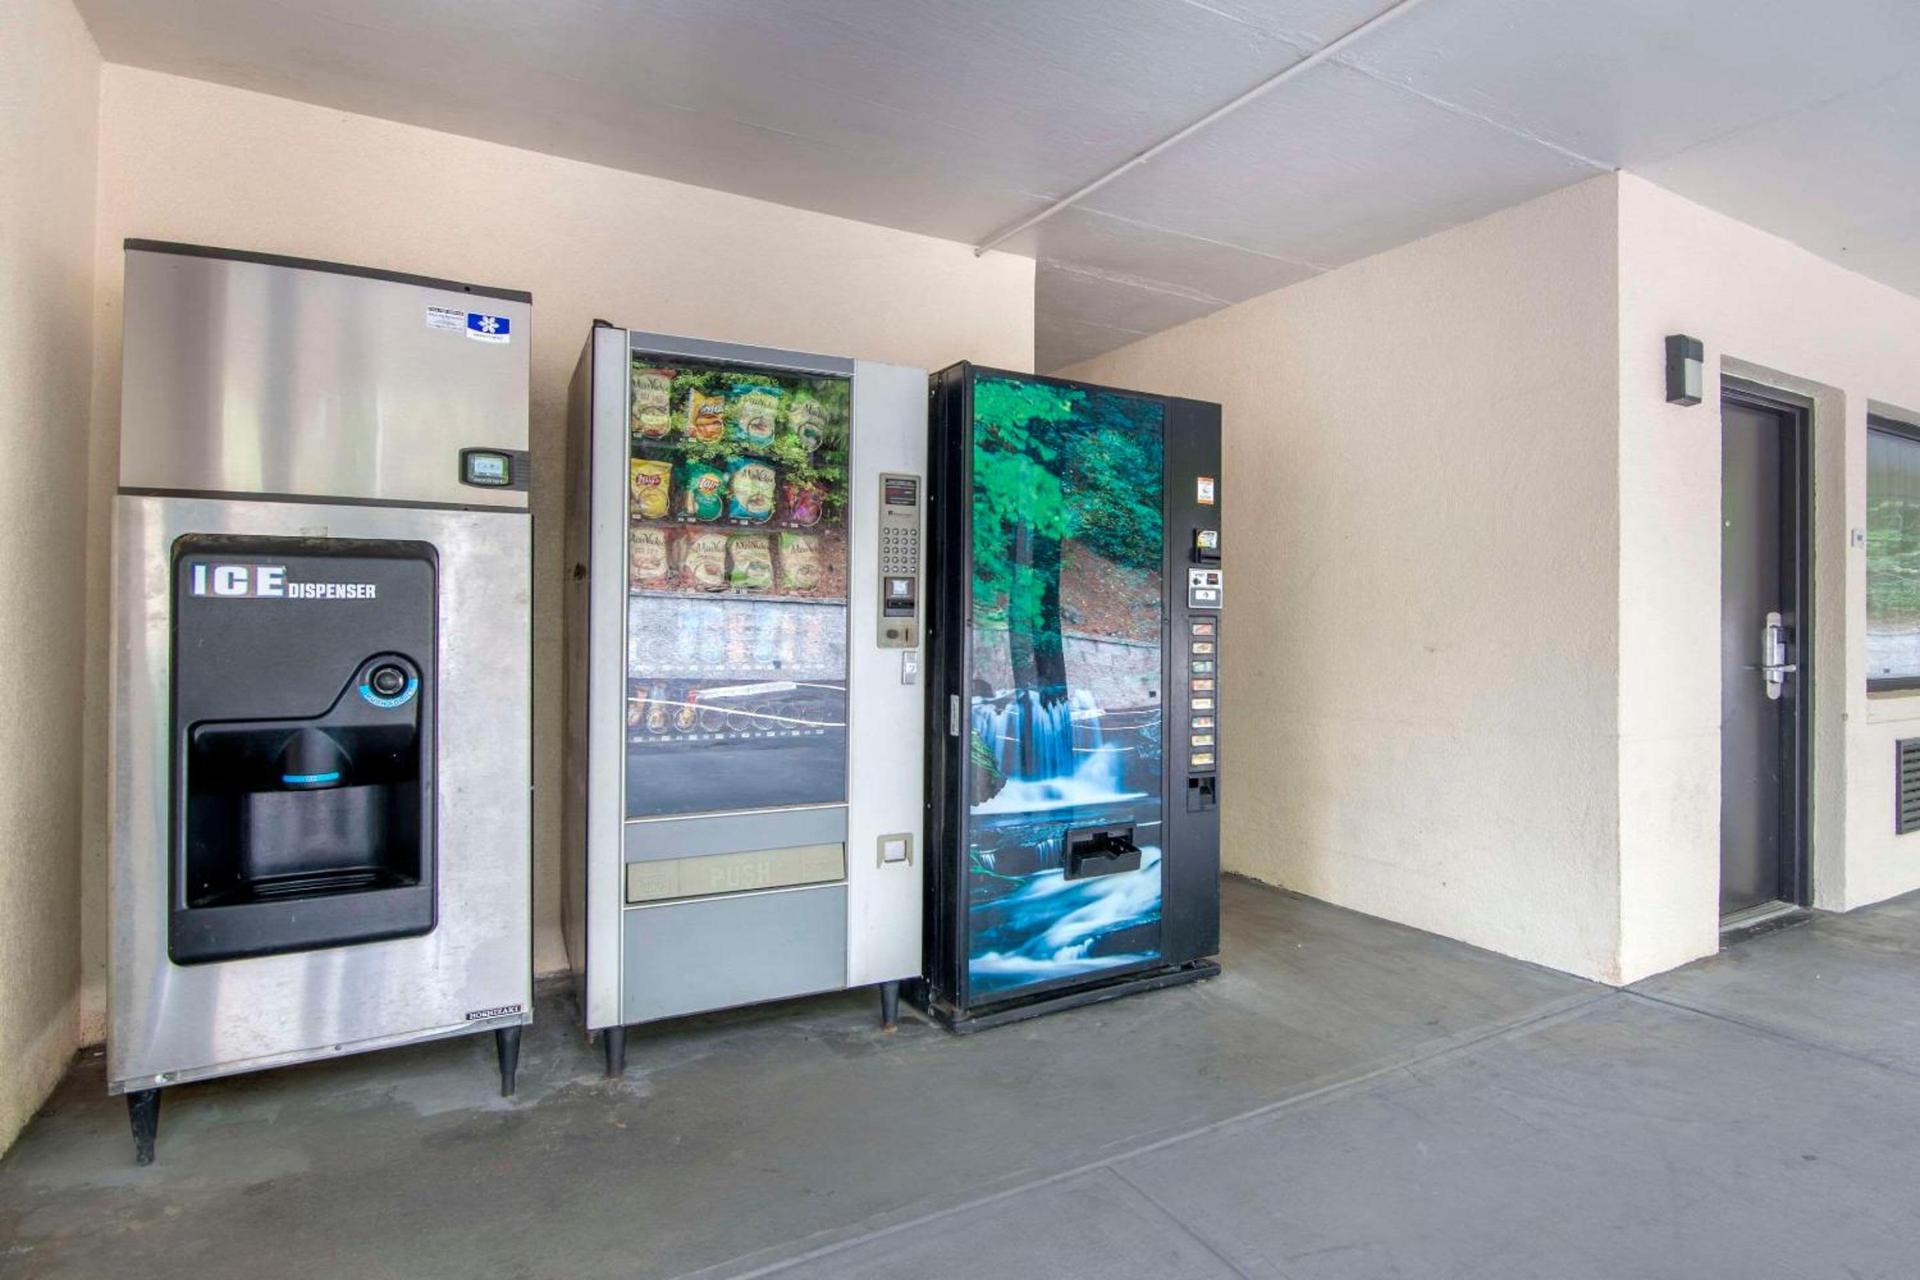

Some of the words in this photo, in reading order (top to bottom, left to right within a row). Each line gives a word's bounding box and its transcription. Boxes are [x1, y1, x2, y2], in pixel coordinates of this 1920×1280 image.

[194, 564, 285, 597] ICE
[289, 582, 377, 599] DISPENSER
[710, 861, 771, 889] PUSH
